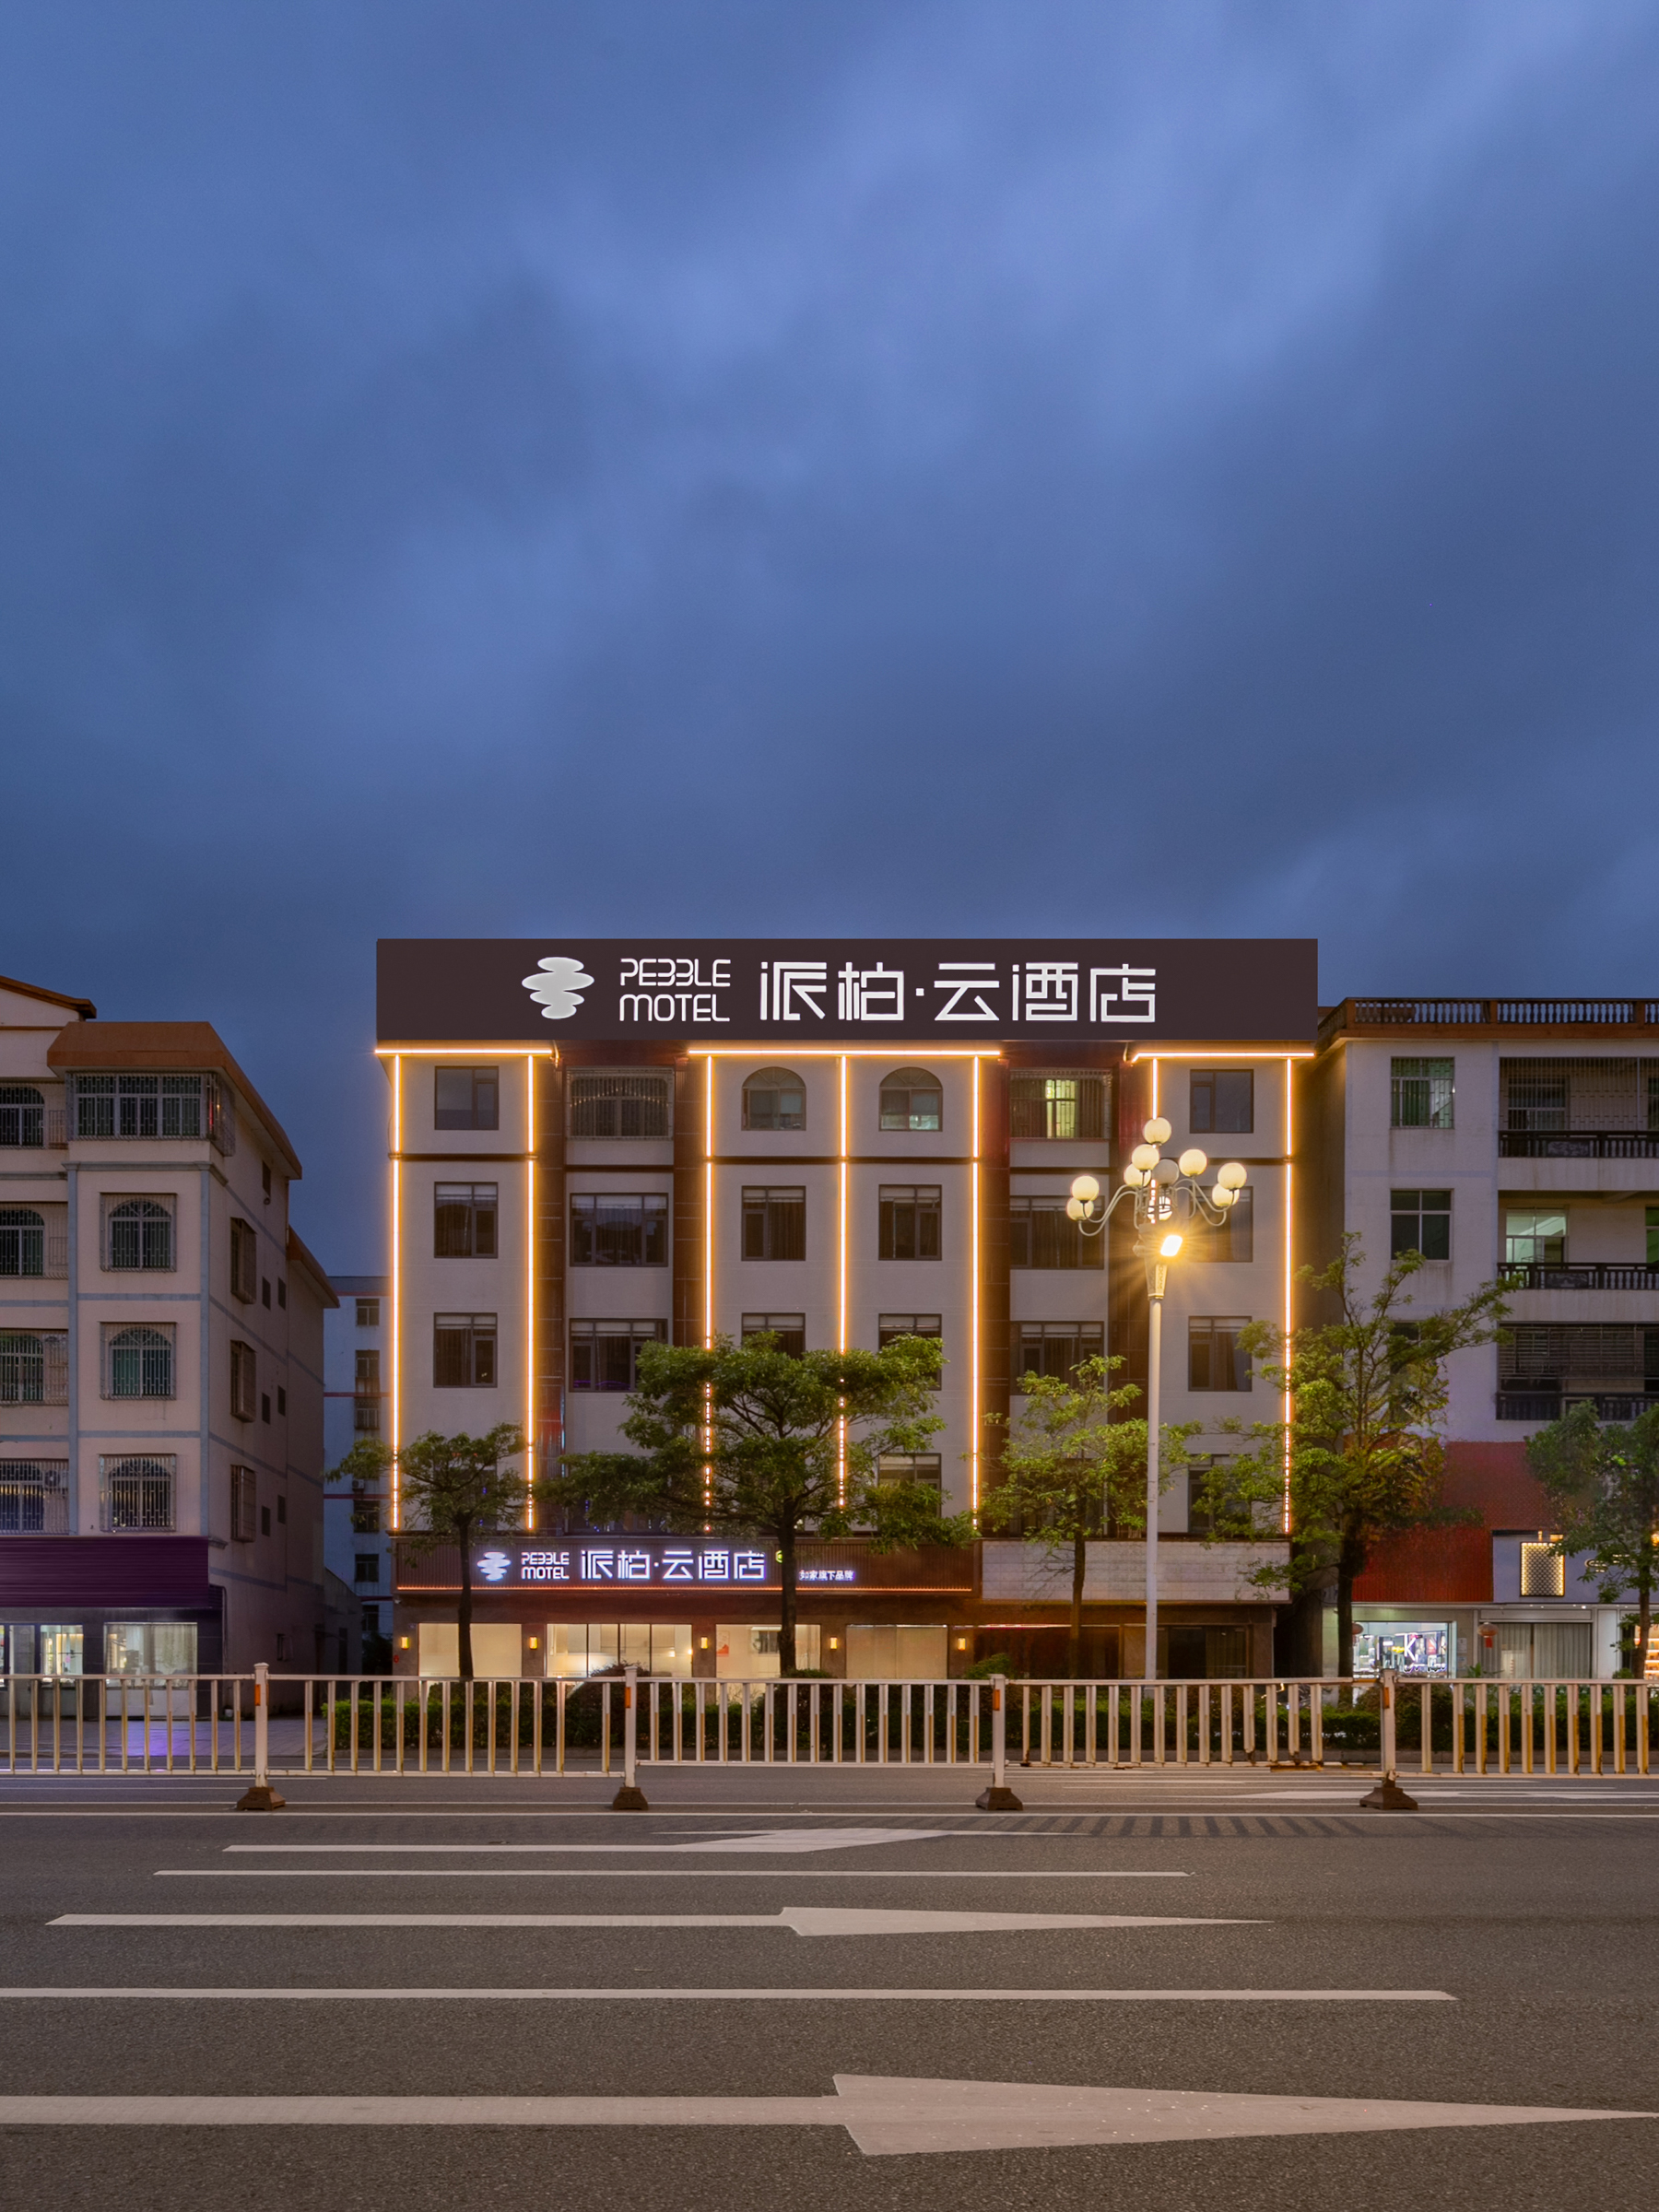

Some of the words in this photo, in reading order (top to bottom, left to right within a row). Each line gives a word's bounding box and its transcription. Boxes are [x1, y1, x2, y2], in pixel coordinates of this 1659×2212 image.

[620, 959, 731, 986] PEBBLE
[620, 994, 730, 1021] MOTEL
[522, 1567, 570, 1579] MOTEL
[798, 1570, 855, 1581] 如家旗下品牌
